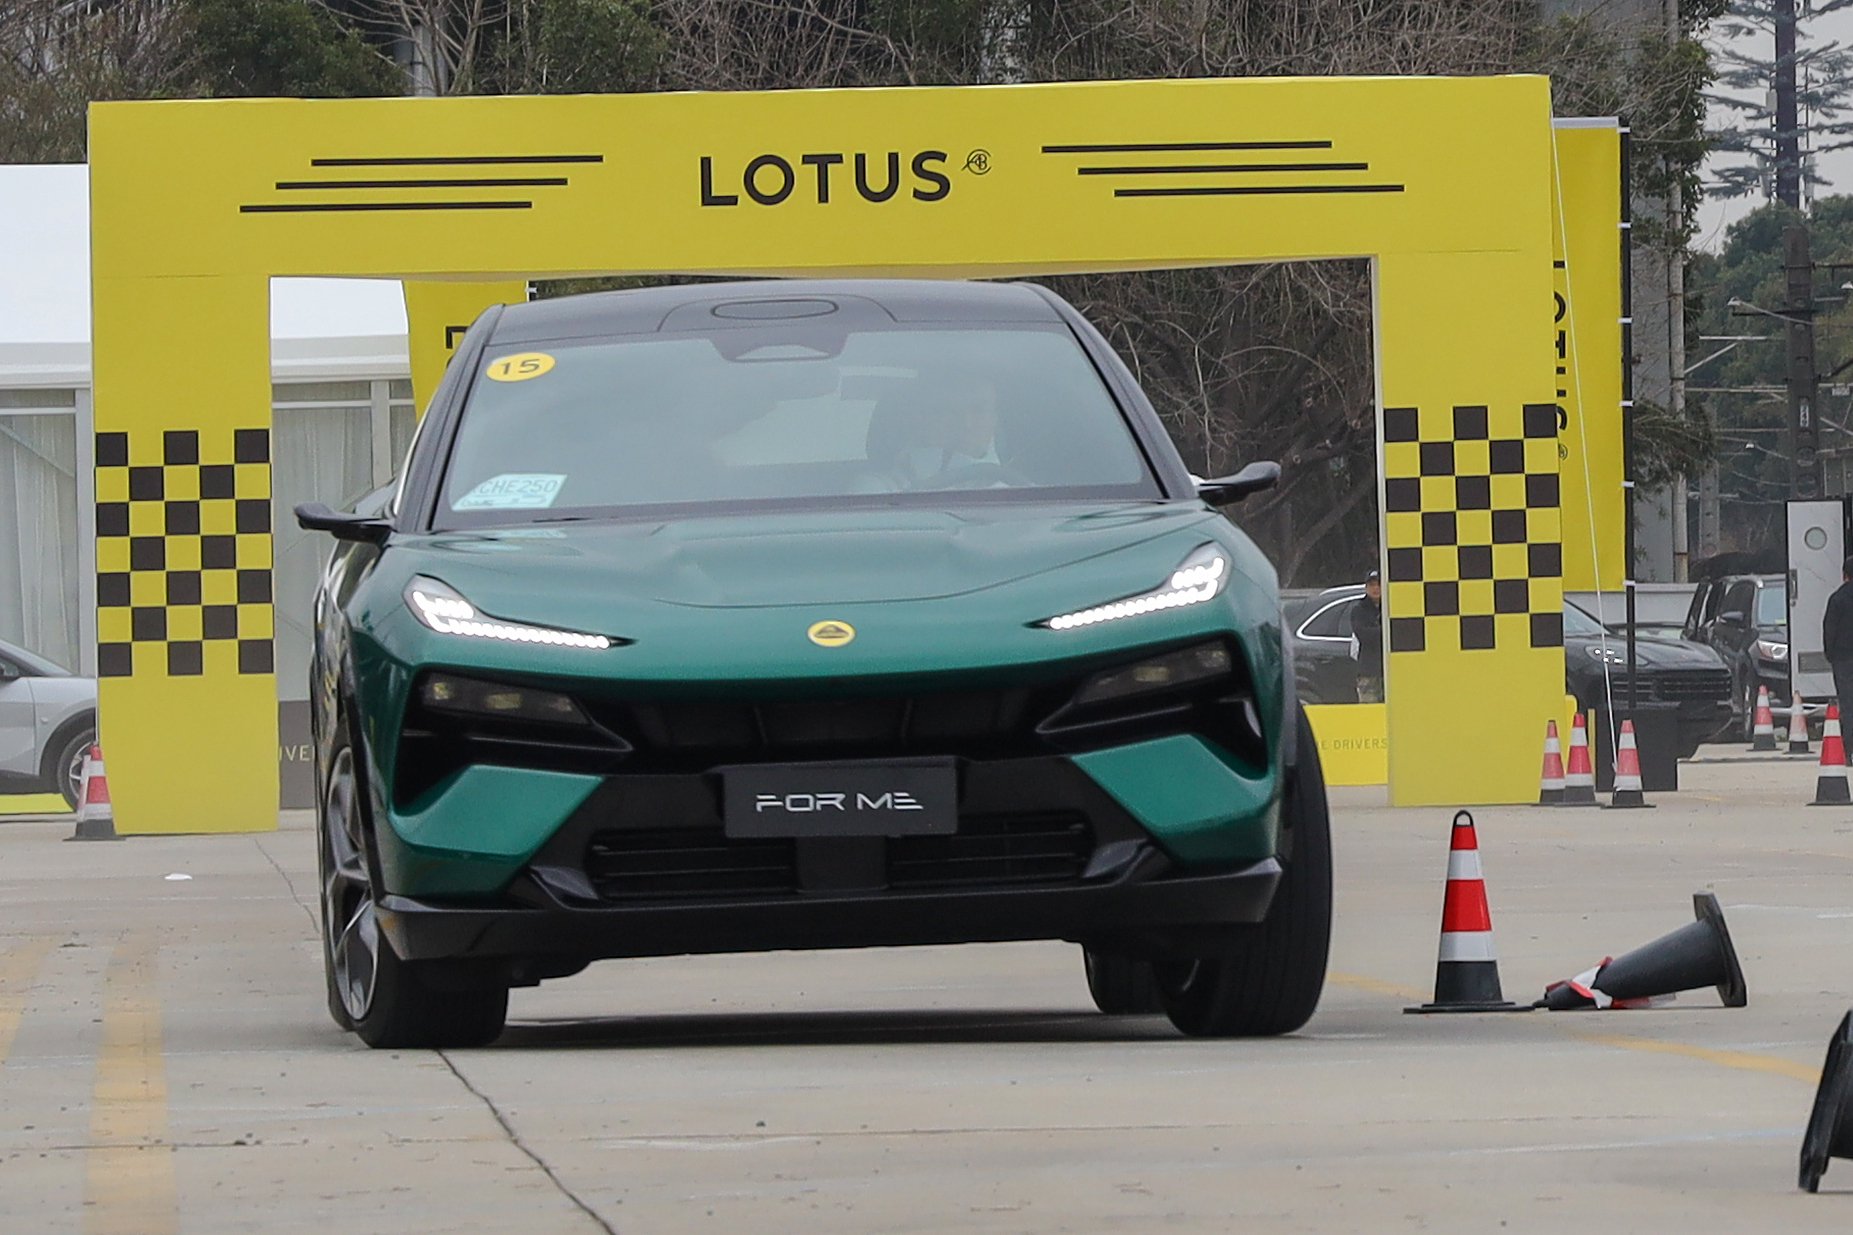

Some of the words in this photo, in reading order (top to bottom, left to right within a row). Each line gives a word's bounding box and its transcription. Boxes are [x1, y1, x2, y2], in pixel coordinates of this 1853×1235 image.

[700, 150, 951, 207] LOTUS
[501, 358, 540, 375] 15
[1333, 738, 1388, 750] DRIVERS
[756, 792, 846, 812] FOR
[856, 791, 924, 811] ME
